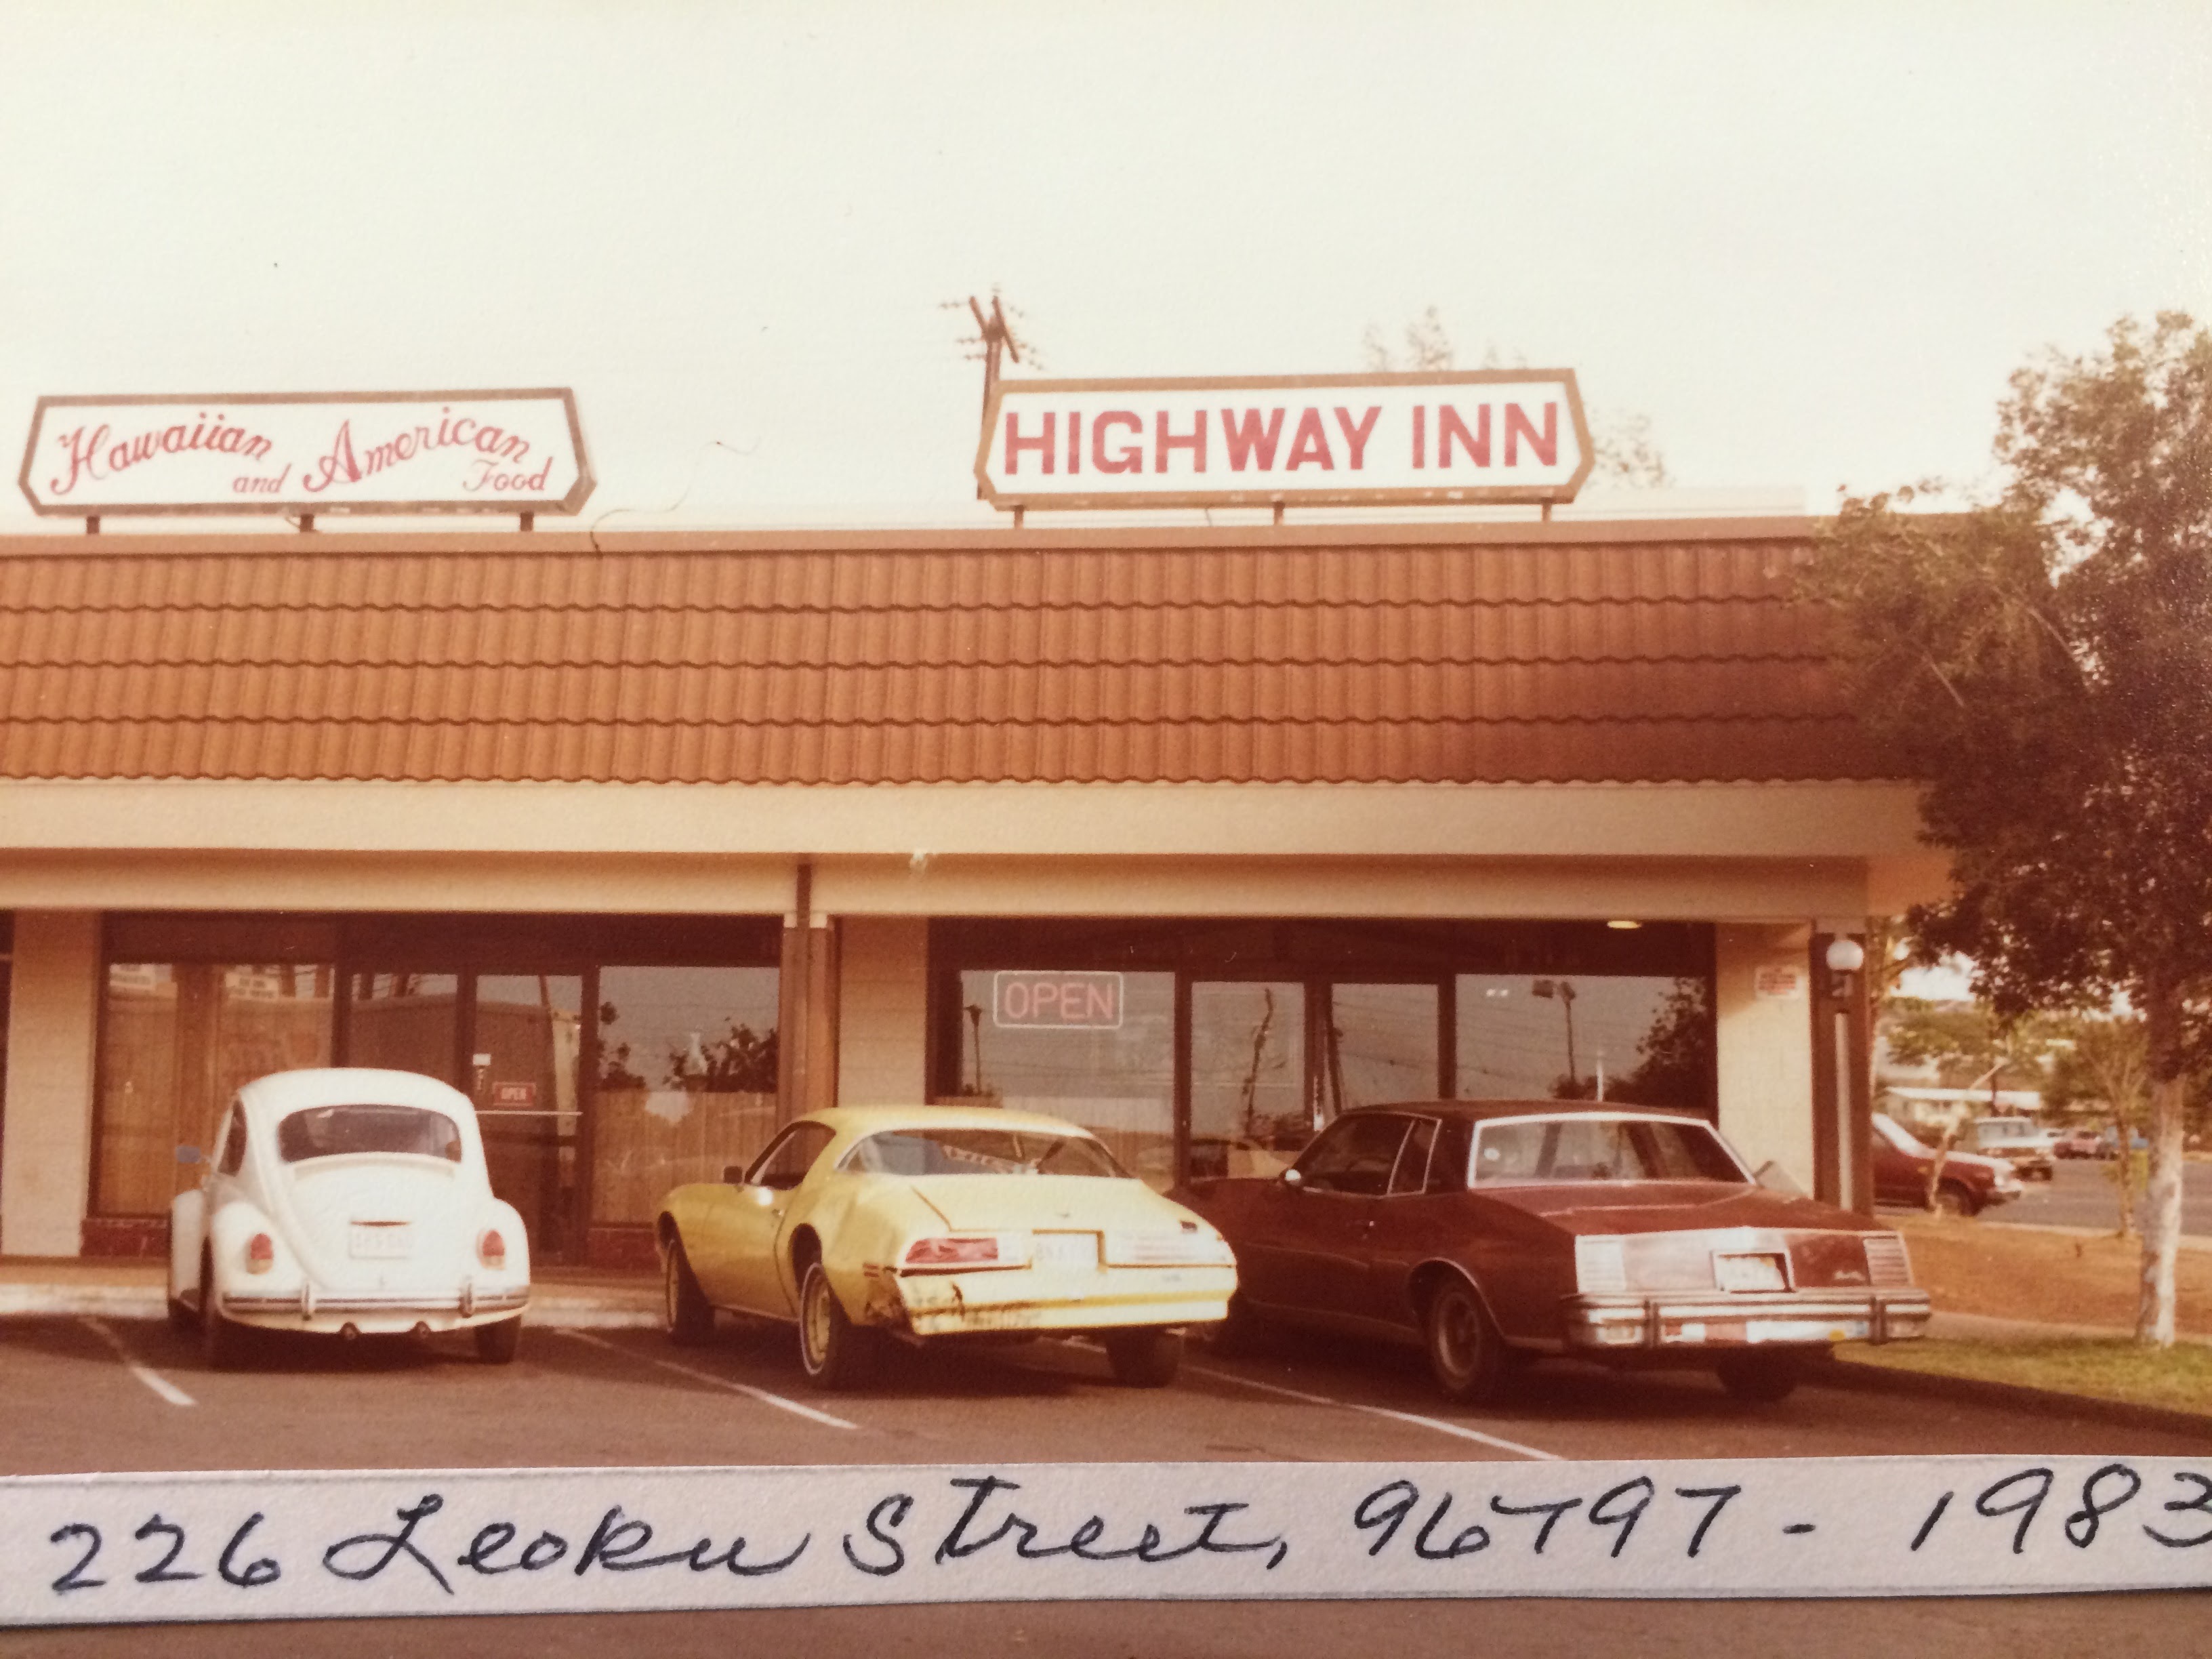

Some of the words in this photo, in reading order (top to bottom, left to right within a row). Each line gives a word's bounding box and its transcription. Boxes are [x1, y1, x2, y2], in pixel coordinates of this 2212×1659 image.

[49, 412, 273, 495] Hawaiian
[233, 464, 291, 493] and
[302, 407, 532, 493] American
[463, 457, 553, 493] Food
[1004, 406, 1382, 475] HIGHWAY
[1412, 402, 1558, 469] INN
[1005, 982, 1113, 1019] OPEN
[51, 1514, 281, 1591] 226
[843, 1475, 1288, 1576] Street,
[1355, 1476, 1742, 1559] 96797
[1910, 1464, 2212, 1554] 1983
